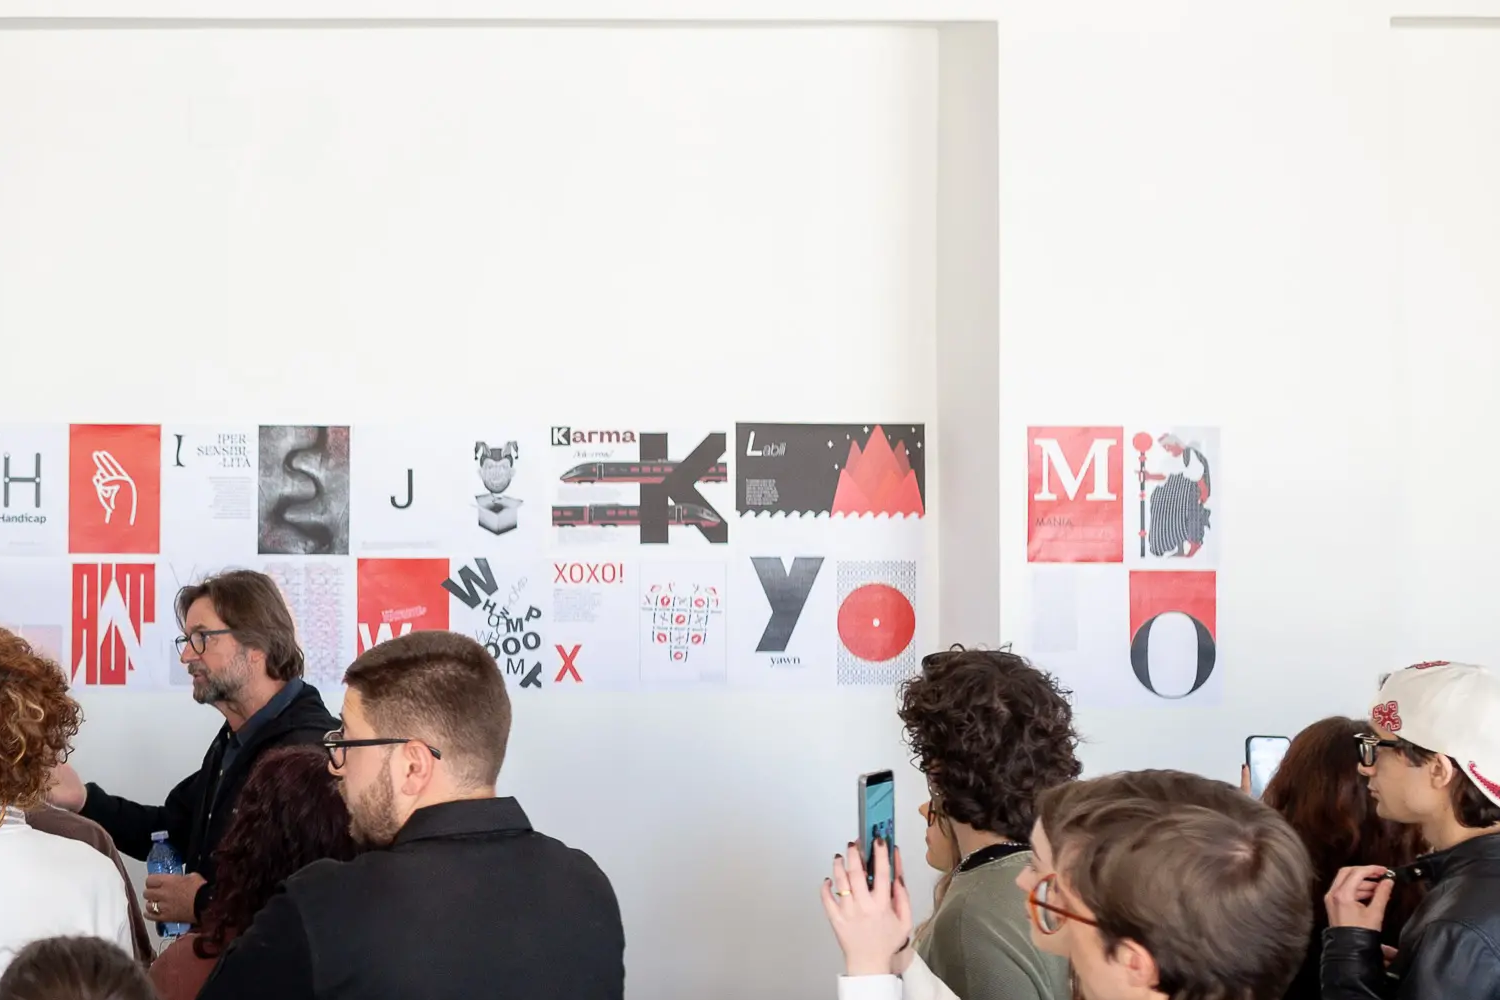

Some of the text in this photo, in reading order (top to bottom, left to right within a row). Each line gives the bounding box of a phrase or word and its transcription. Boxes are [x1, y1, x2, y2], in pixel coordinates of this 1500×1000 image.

[551, 426, 636, 446] Karma
[3, 452, 41, 508] H
[1033, 438, 1117, 501] M
[390, 469, 413, 509] J
[1035, 517, 1073, 527] MANIA
[553, 563, 624, 584] XOXO!
[554, 645, 583, 683] X
[770, 656, 801, 668] yawn
